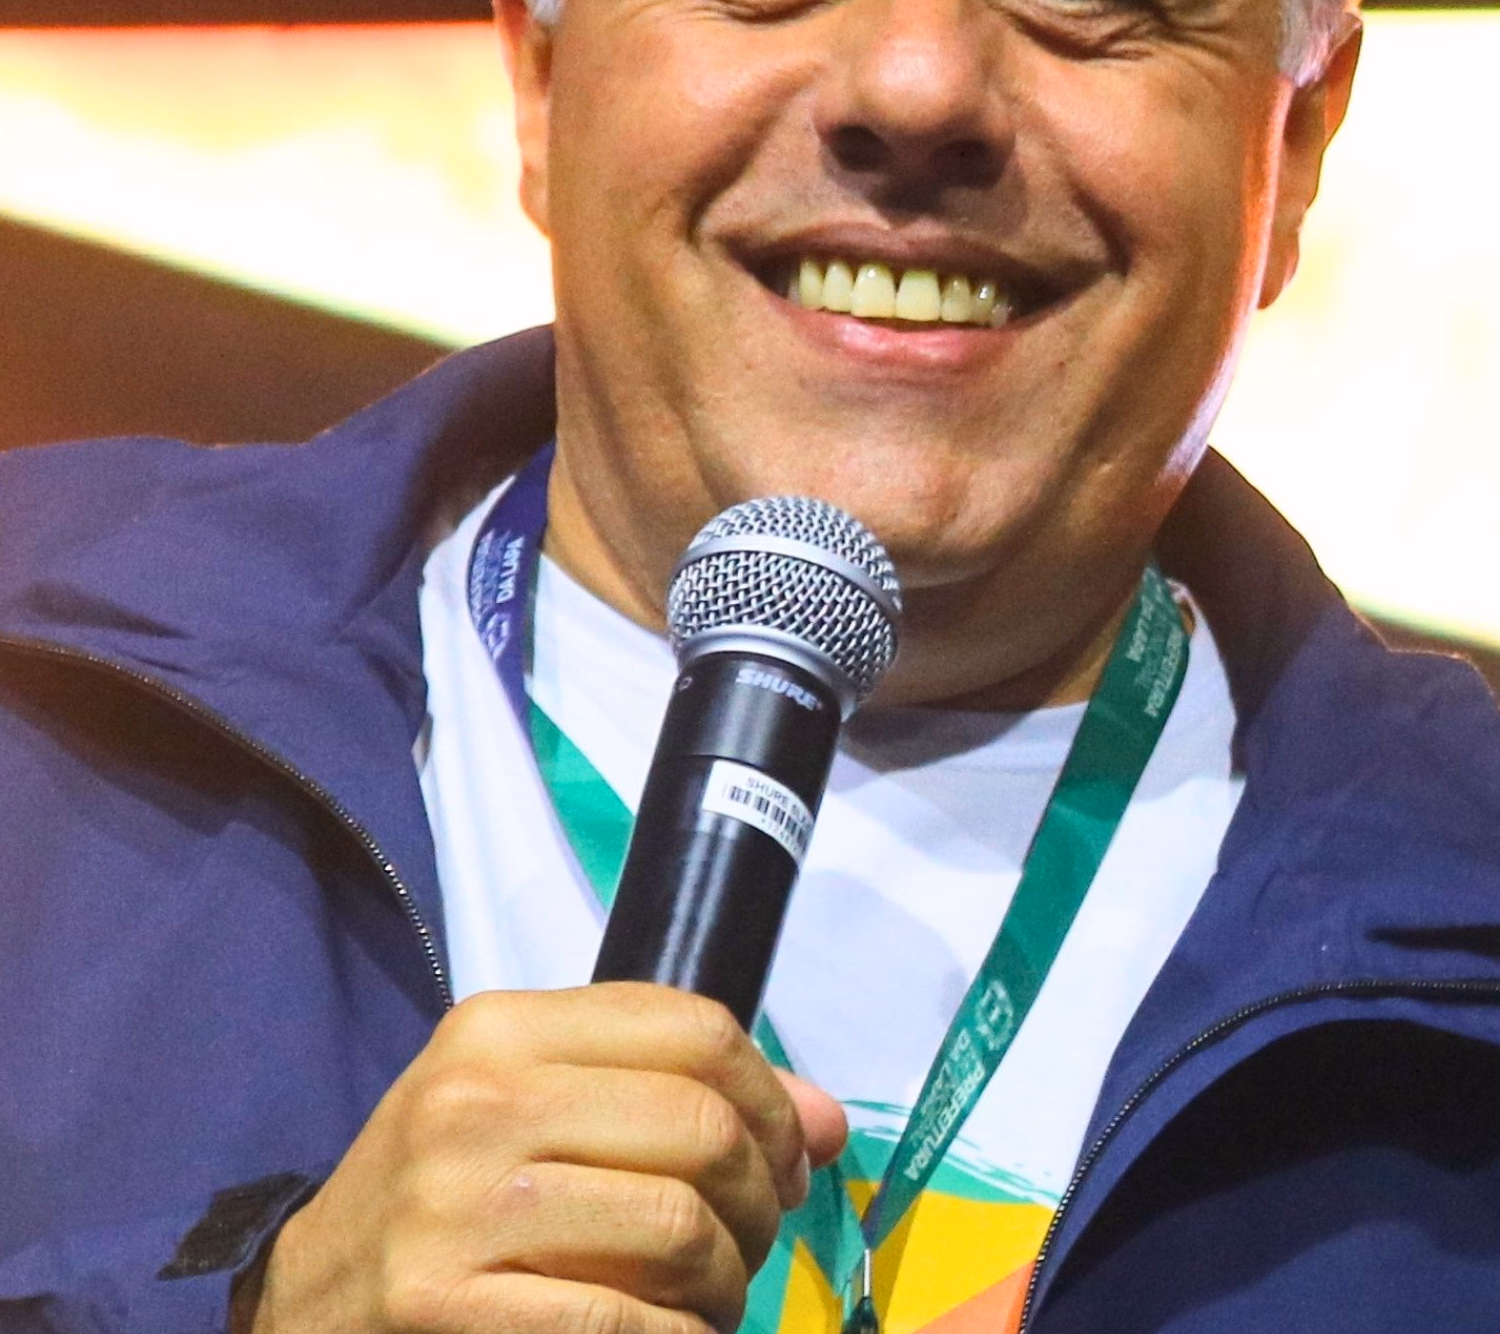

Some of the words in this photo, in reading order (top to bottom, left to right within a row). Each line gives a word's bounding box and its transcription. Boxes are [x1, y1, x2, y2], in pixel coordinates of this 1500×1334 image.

[500, 536, 525, 578] LAPA
[496, 576, 516, 604] DA
[735, 668, 818, 711] SHURE
[747, 776, 790, 806] SHURE
[903, 1061, 986, 1181] PREFEITURA
